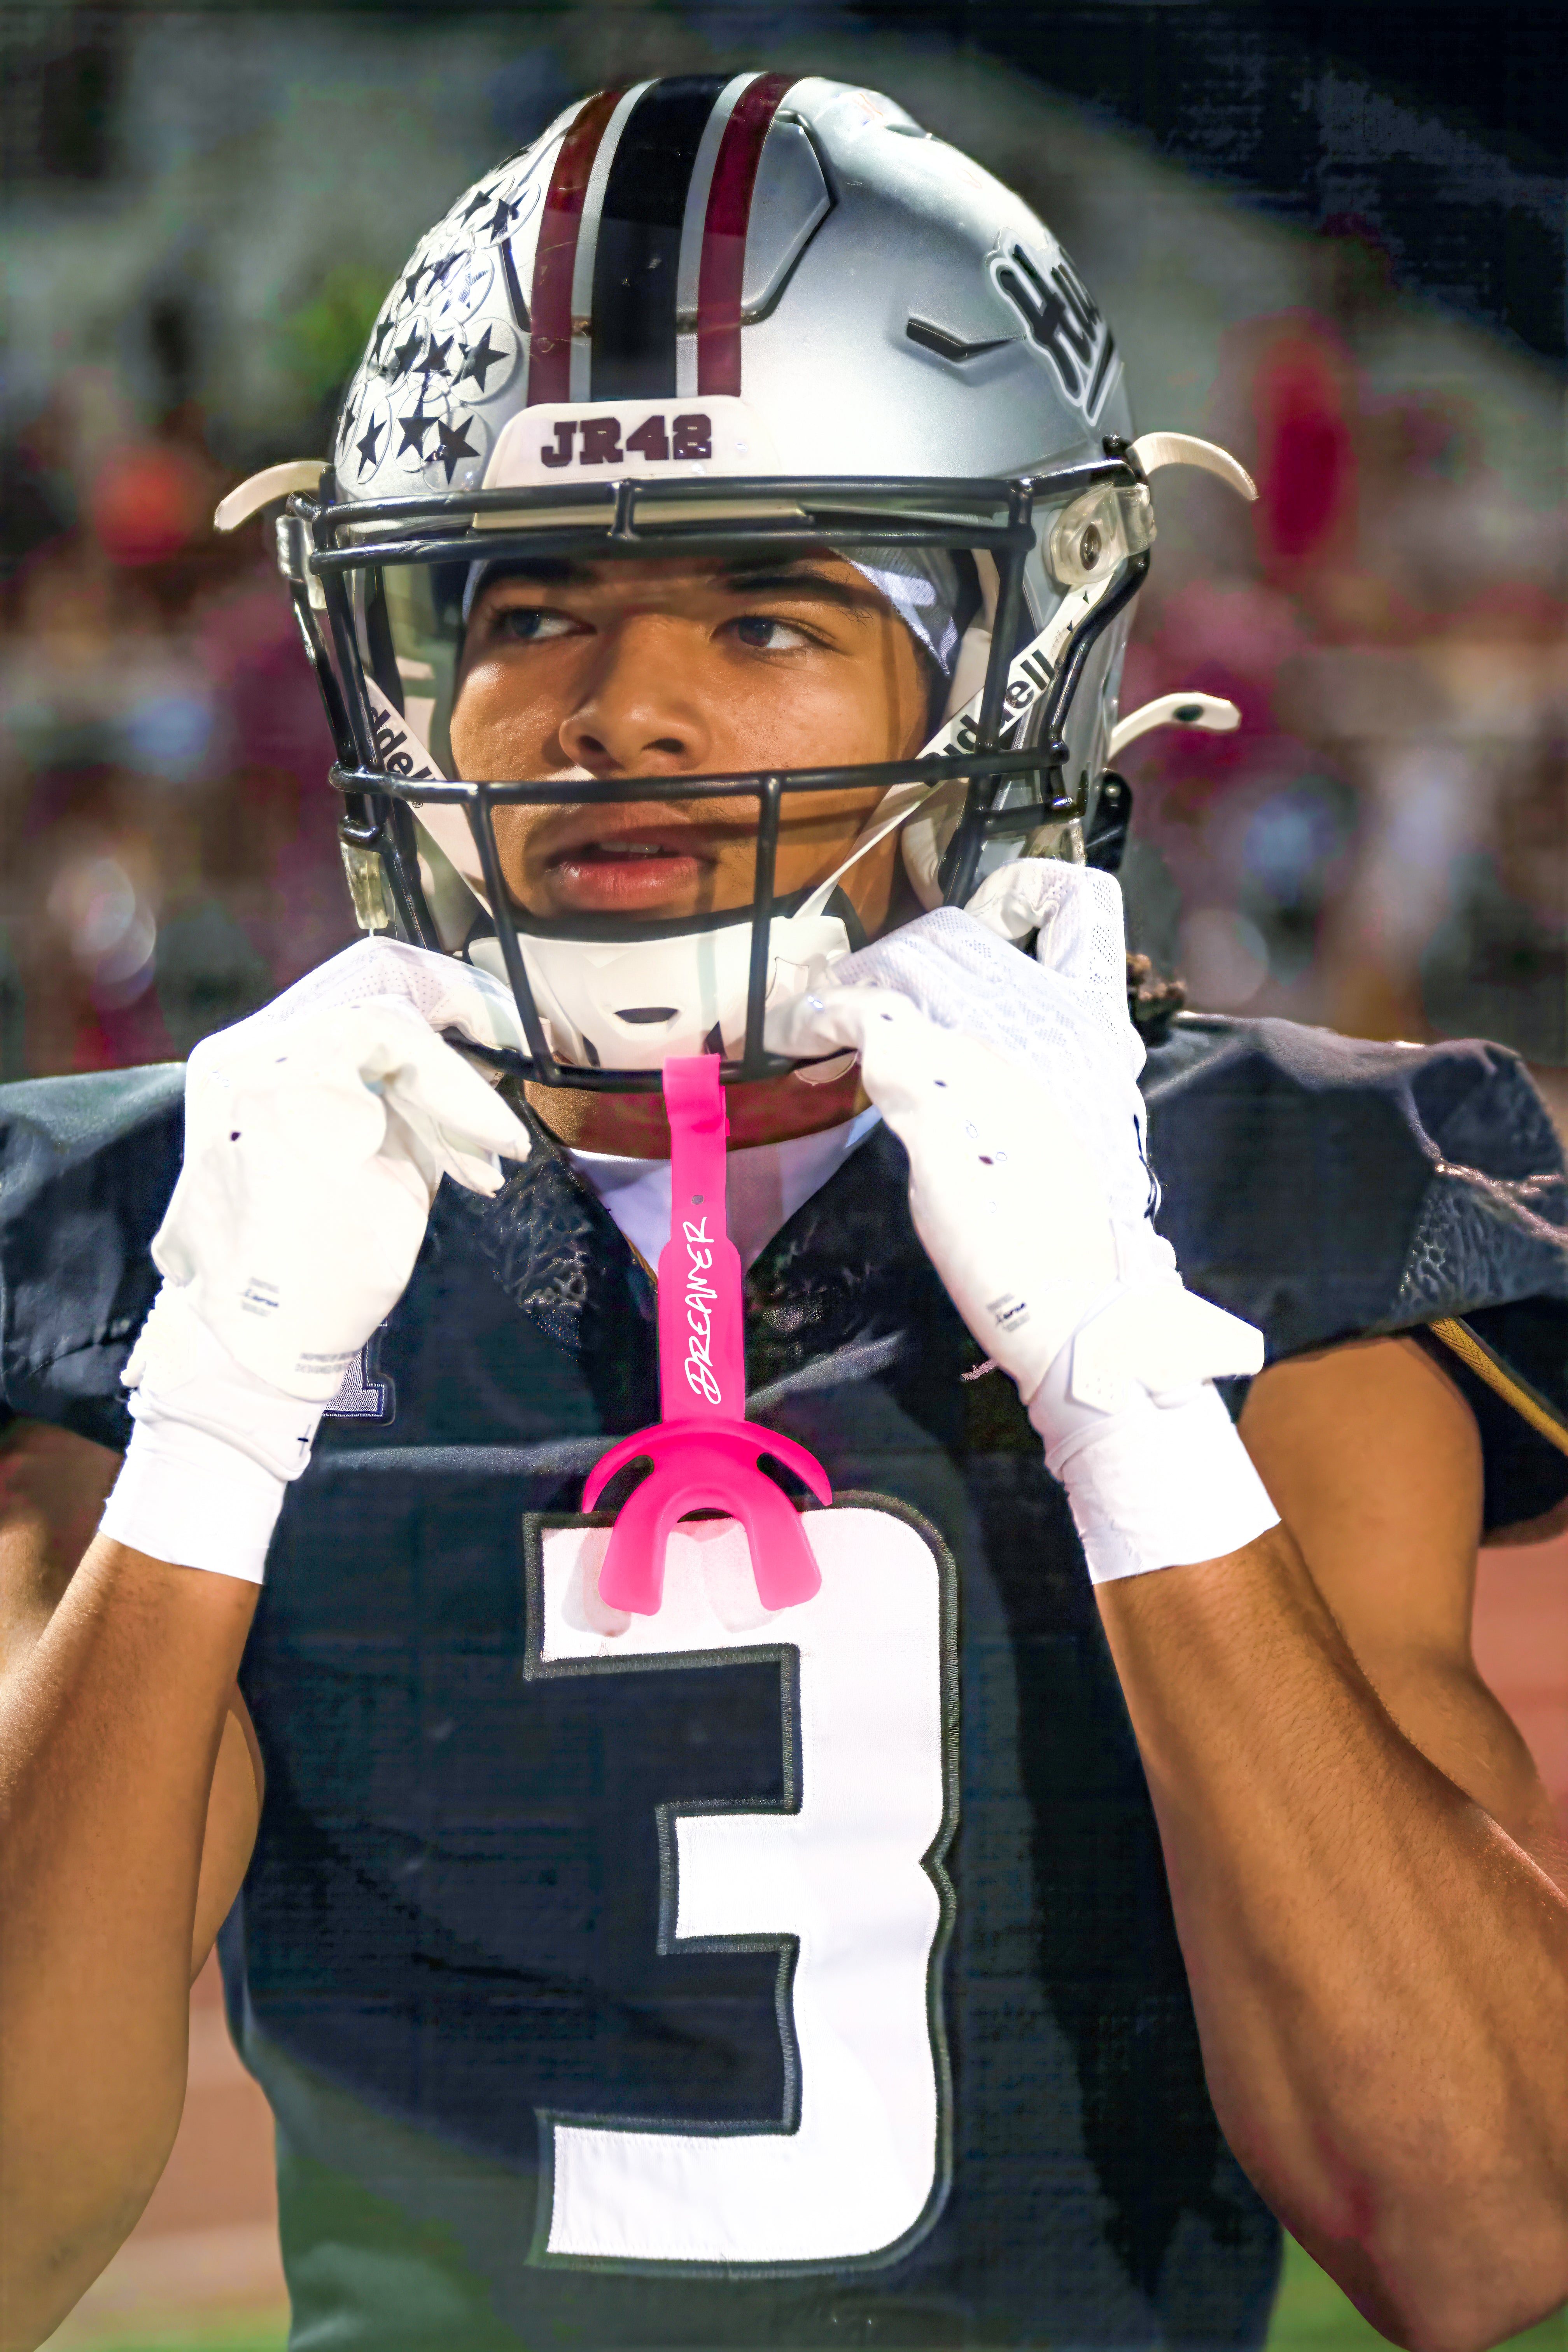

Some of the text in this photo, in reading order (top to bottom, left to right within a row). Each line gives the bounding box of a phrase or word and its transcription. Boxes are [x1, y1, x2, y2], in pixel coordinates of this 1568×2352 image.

[541, 413, 712, 467] JR48
[682, 1216, 721, 1404] DREAMER
[525, 1493, 957, 2275] 3
